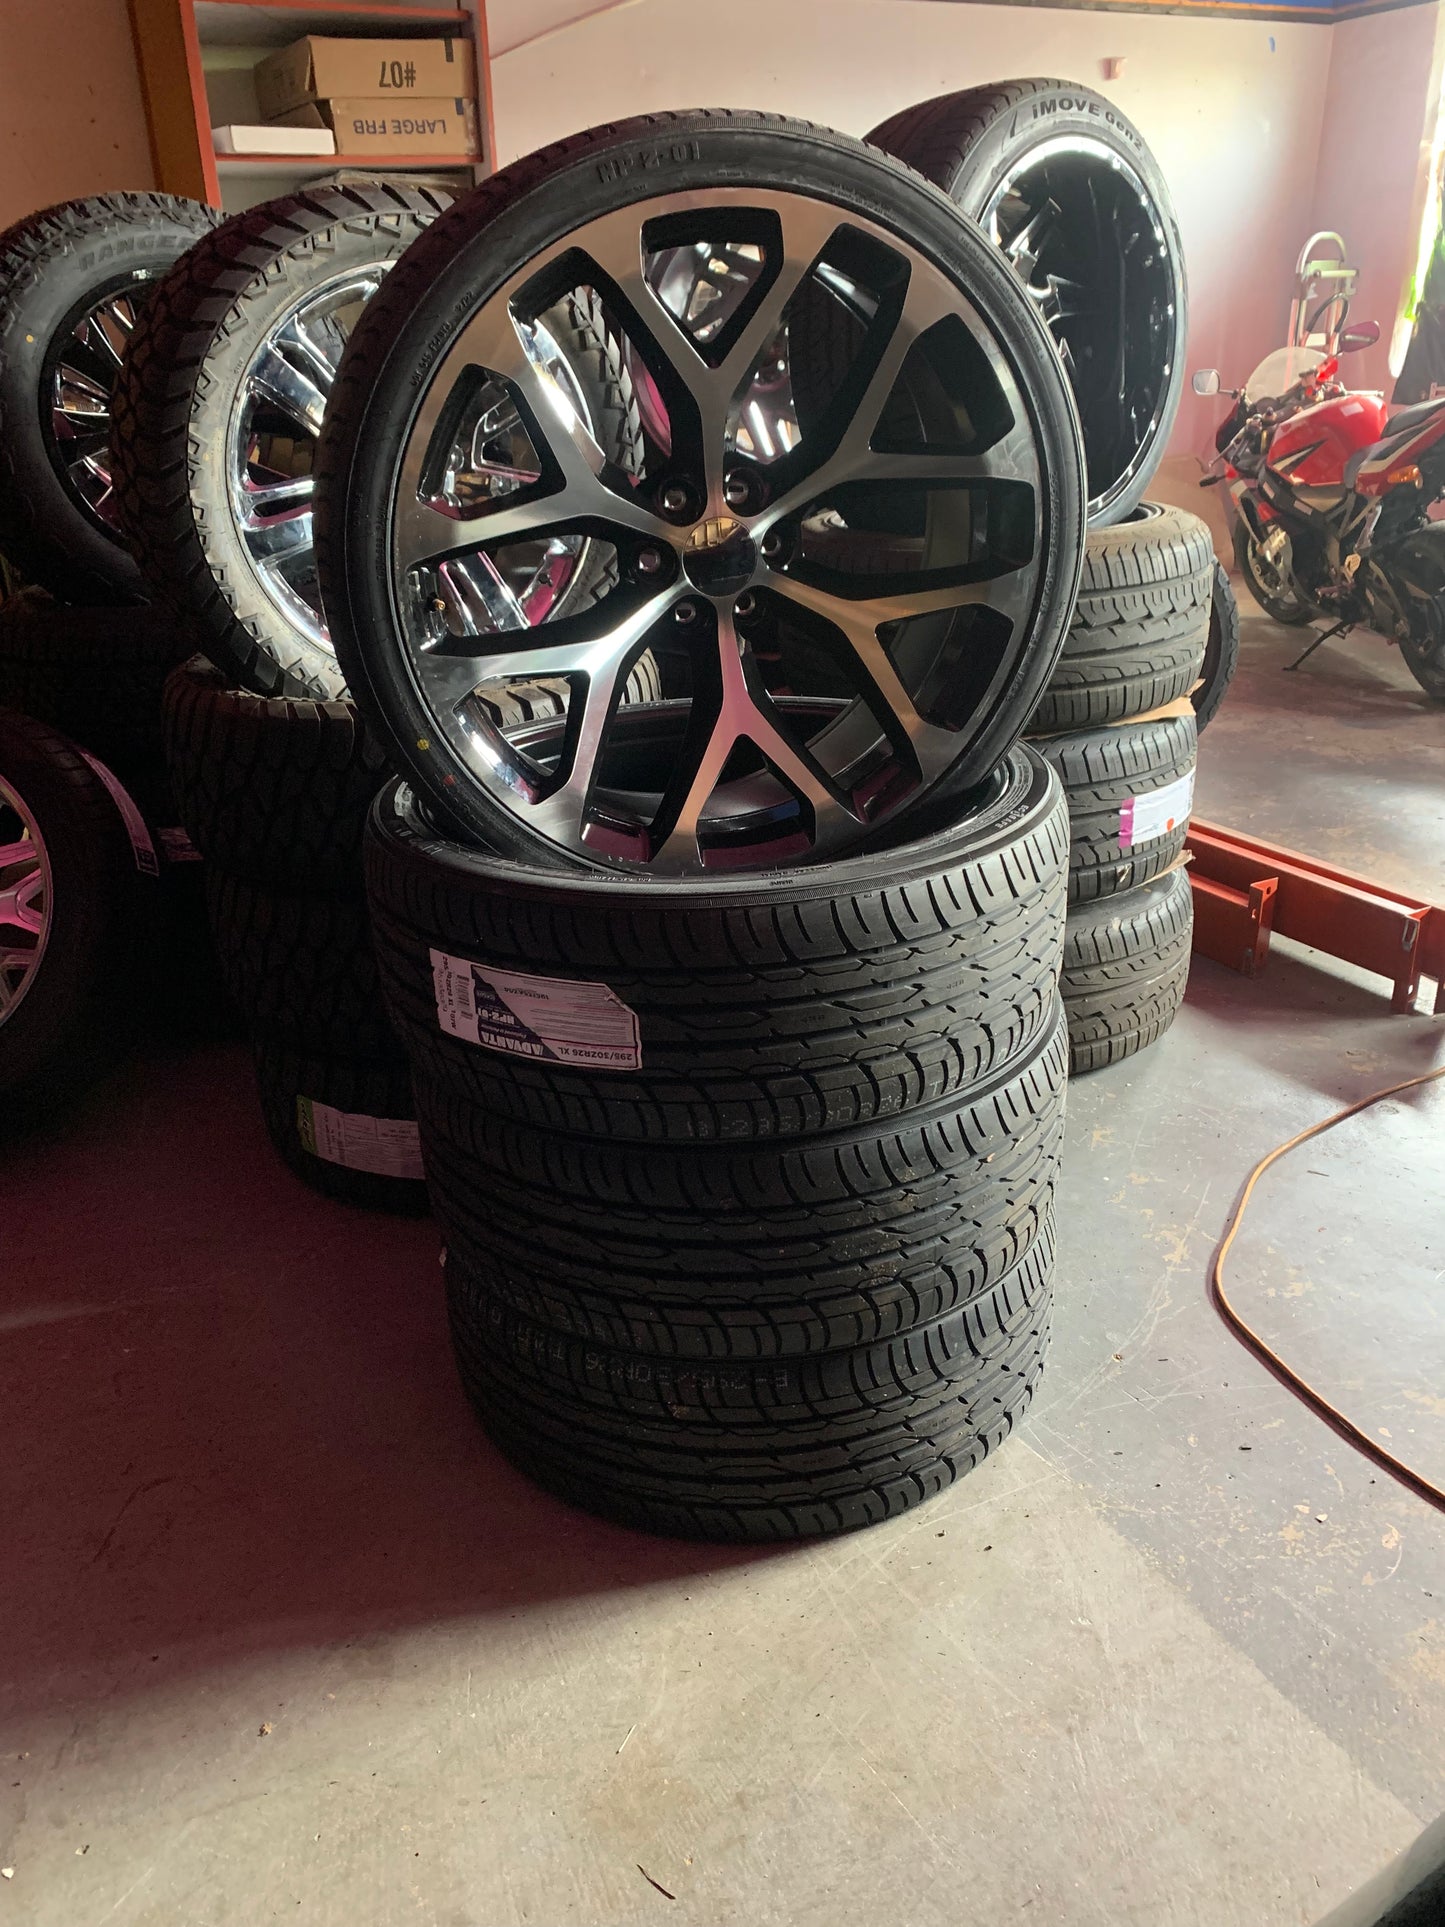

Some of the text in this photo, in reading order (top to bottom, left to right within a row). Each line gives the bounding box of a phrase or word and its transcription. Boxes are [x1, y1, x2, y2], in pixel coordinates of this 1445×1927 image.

[379, 61, 416, 88] #07
[353, 119, 447, 134] LARGE FRB
[1032, 98, 1142, 150] iMOVE Gen2
[480, 1030, 544, 1056] ADVANTA
[558, 1046, 570, 1055] XL
[572, 1049, 633, 1061] 295/30ZR26
